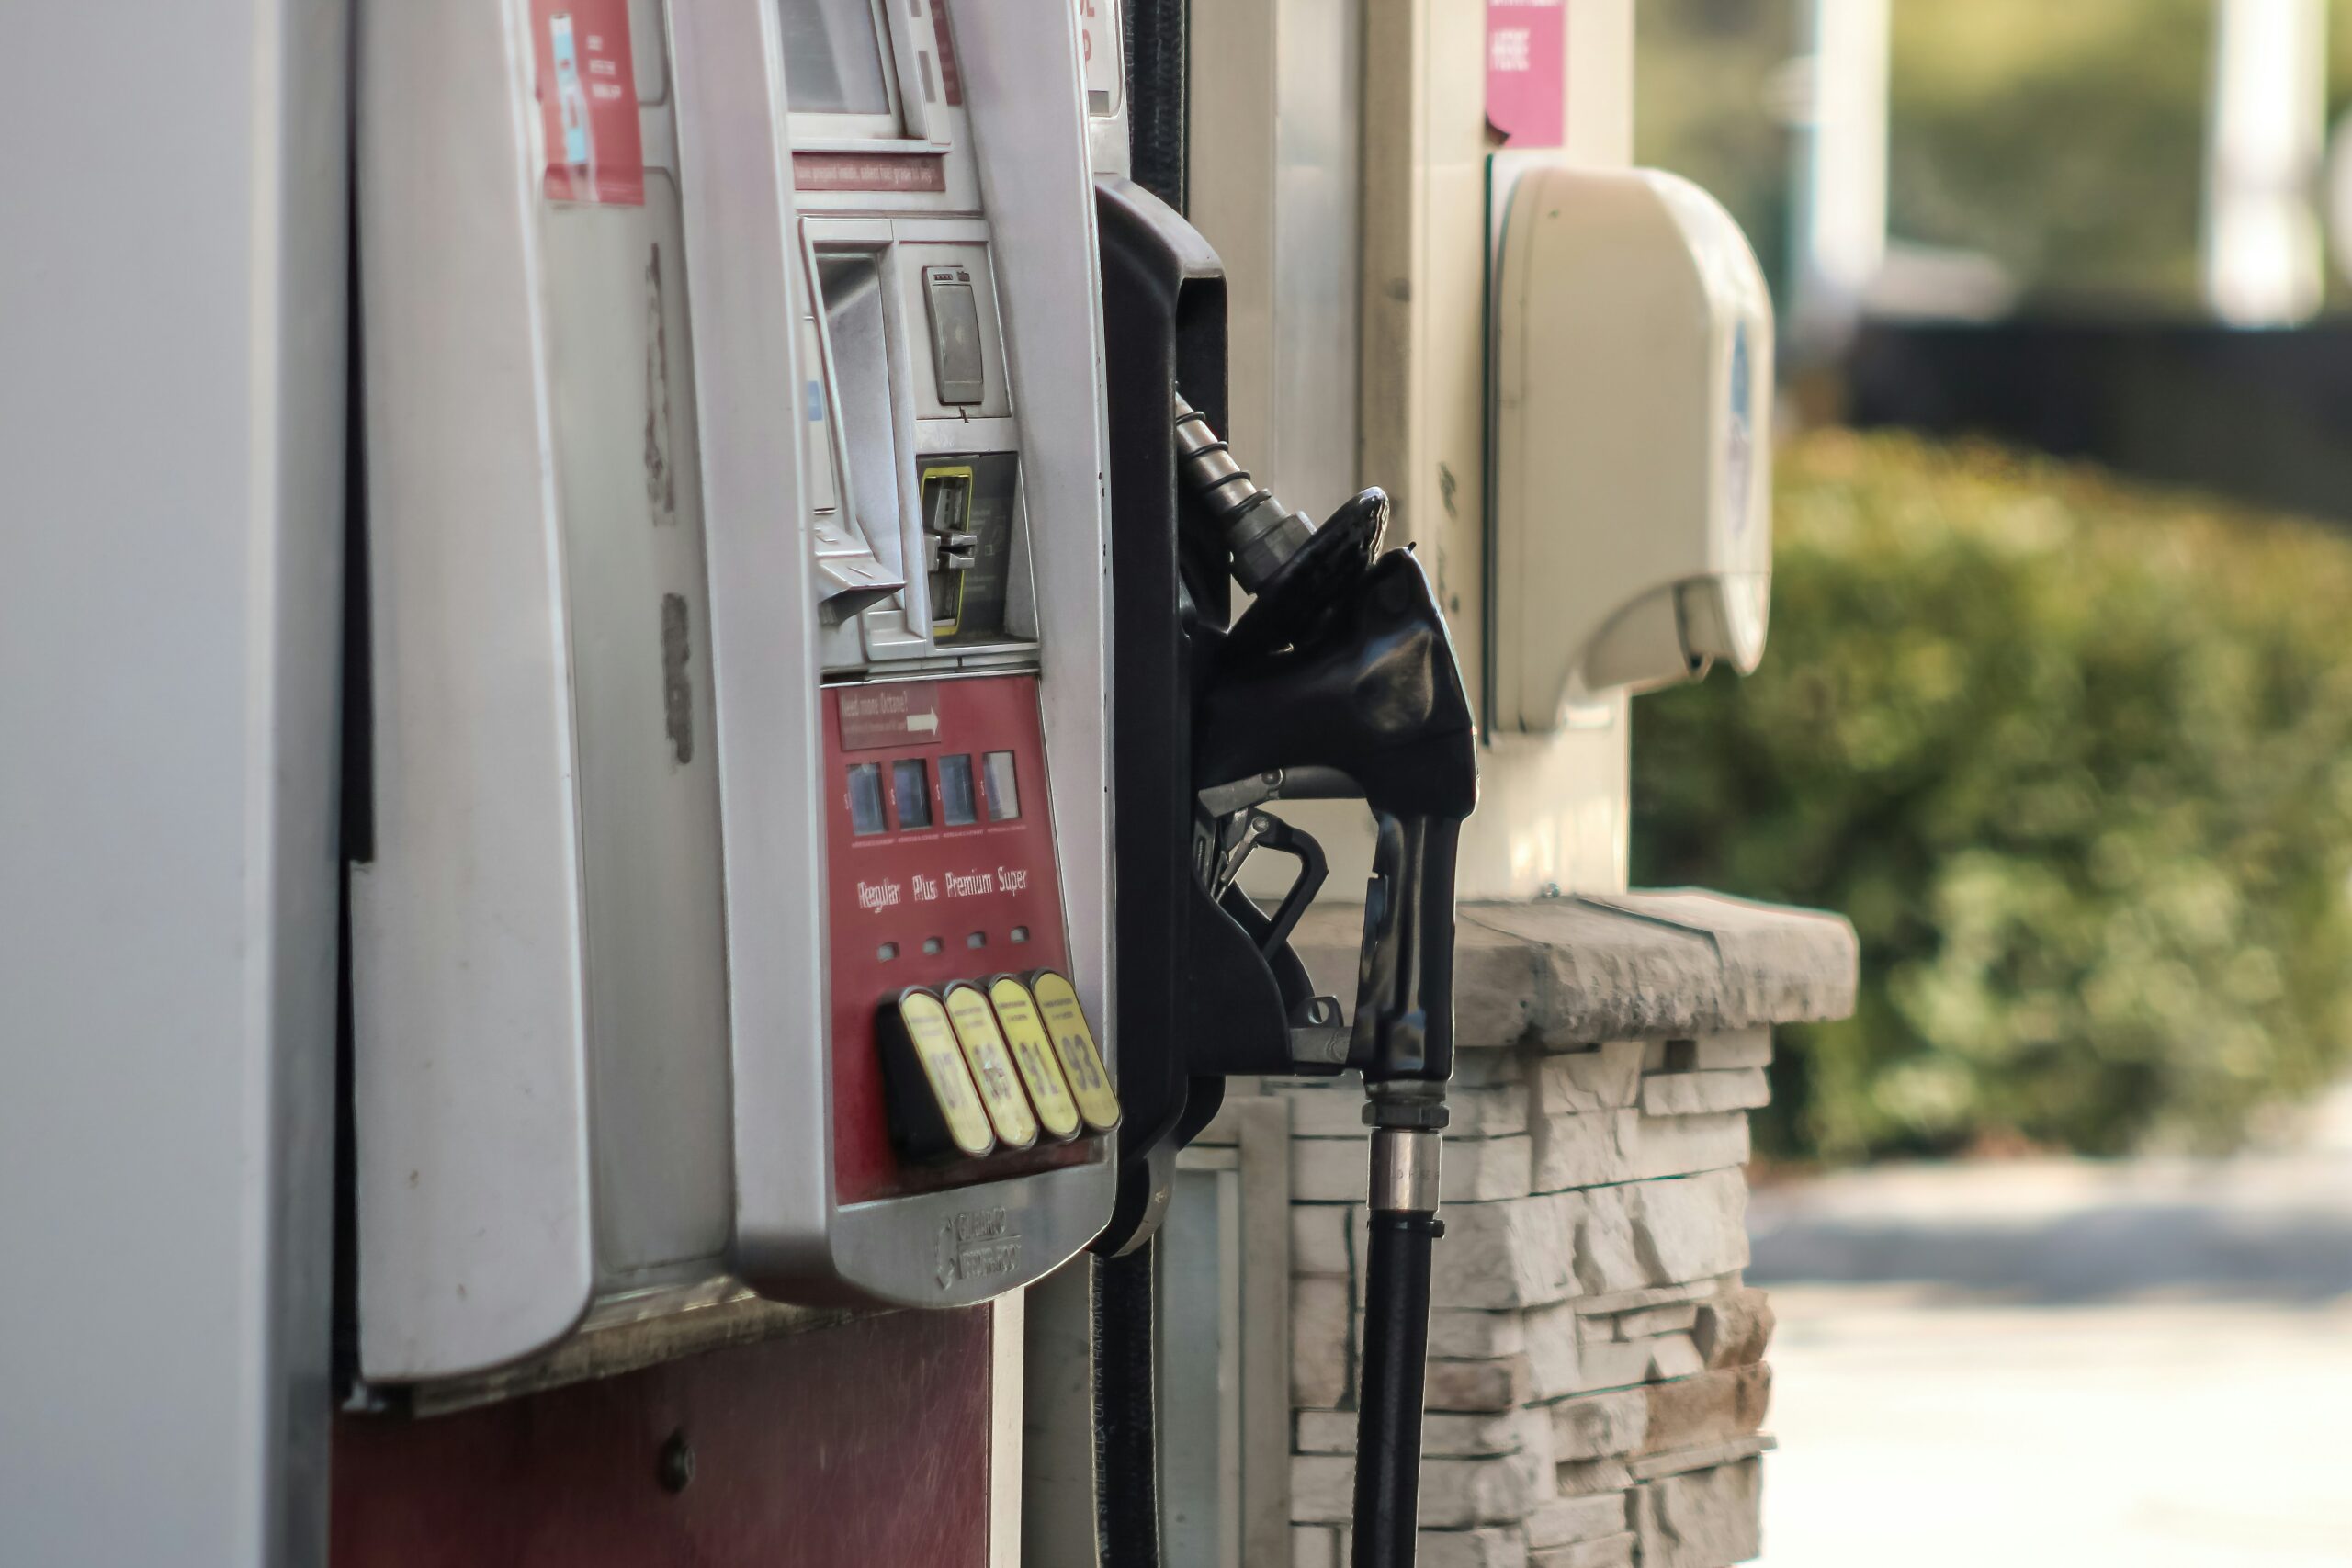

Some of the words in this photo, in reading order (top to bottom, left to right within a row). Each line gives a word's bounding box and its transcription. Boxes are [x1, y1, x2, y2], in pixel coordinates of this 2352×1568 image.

[857, 876, 902, 914] Regular
[912, 874, 938, 902] Plus
[945, 868, 993, 898] Premium
[997, 866, 1028, 897] Super
[1061, 1034, 1101, 1091] 93
[1094, 1366, 1104, 1419] ULTRA
